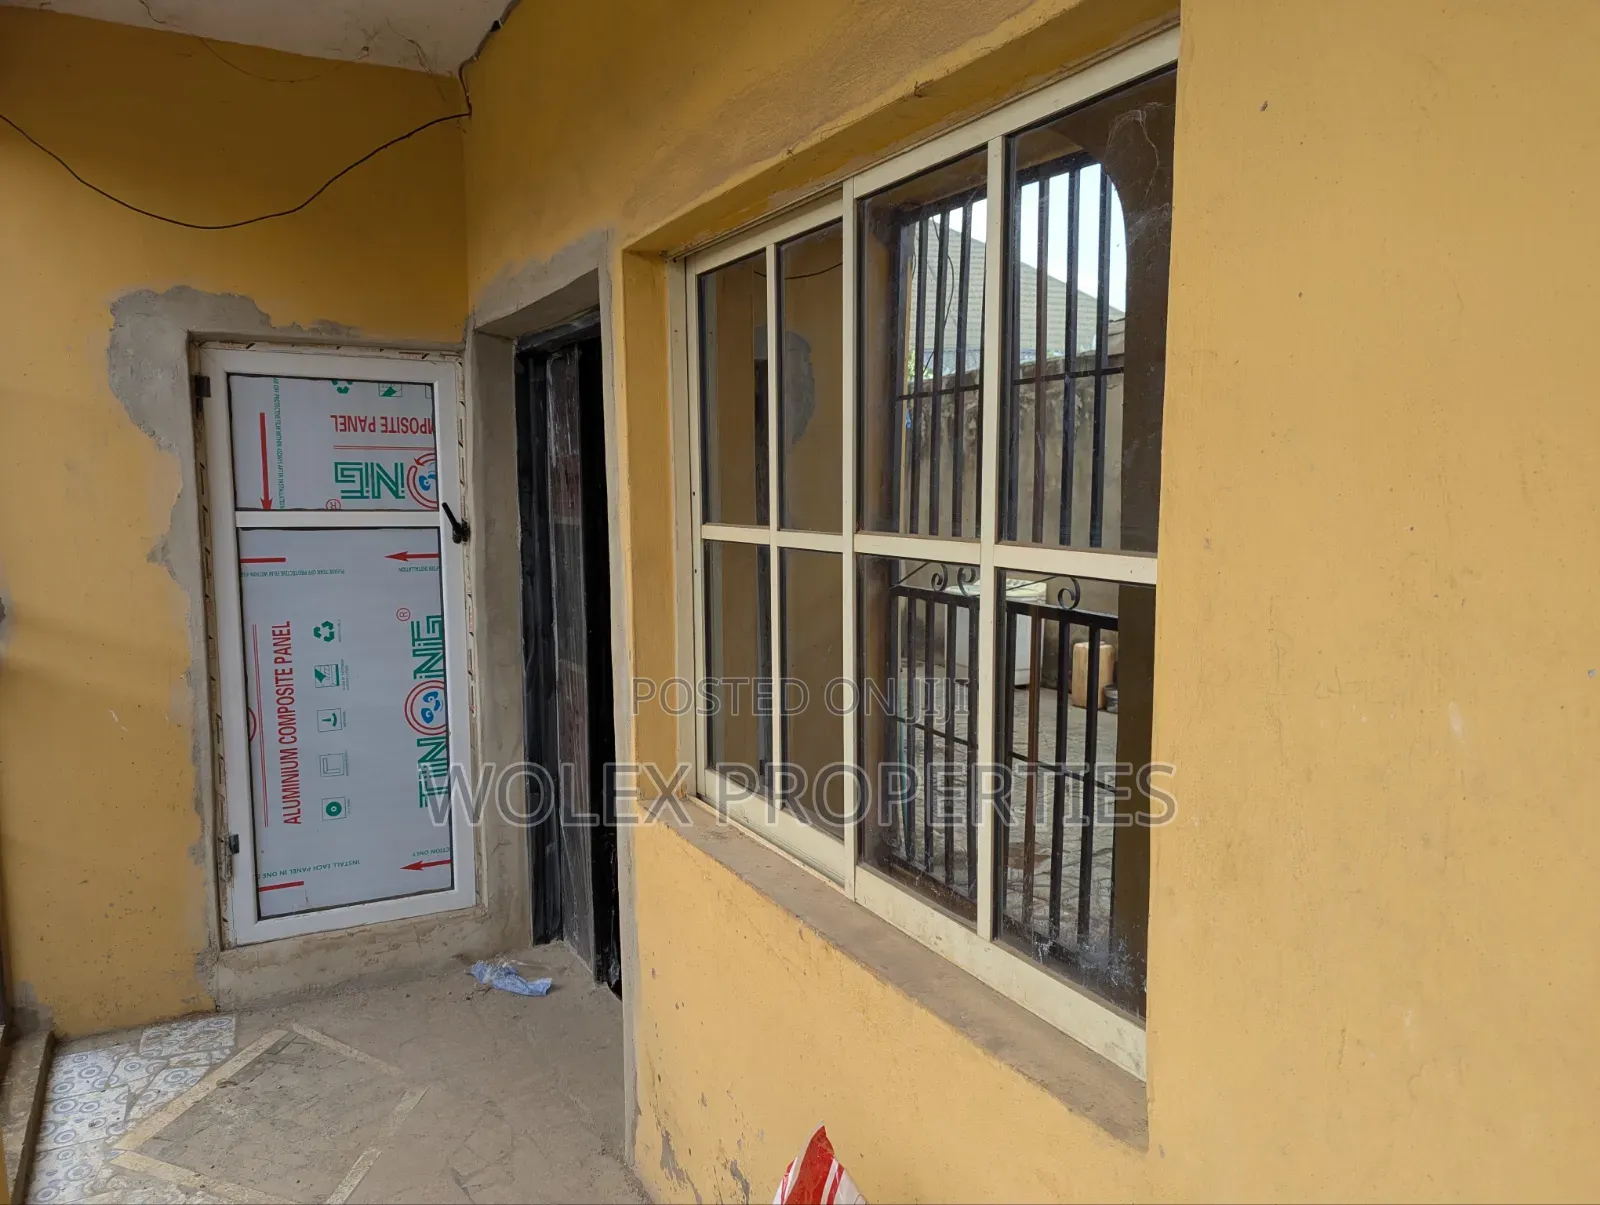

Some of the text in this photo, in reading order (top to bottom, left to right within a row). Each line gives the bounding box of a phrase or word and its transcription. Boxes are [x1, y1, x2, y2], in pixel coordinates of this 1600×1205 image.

[330, 414, 376, 433] PANEL
[272, 620, 302, 825] ALUMINIUM COMPOSITE PANEL
[313, 863, 331, 871] EACH
[333, 859, 360, 869] INSTALL
[261, 871, 278, 879] ONE
[289, 866, 312, 875] PANEL
